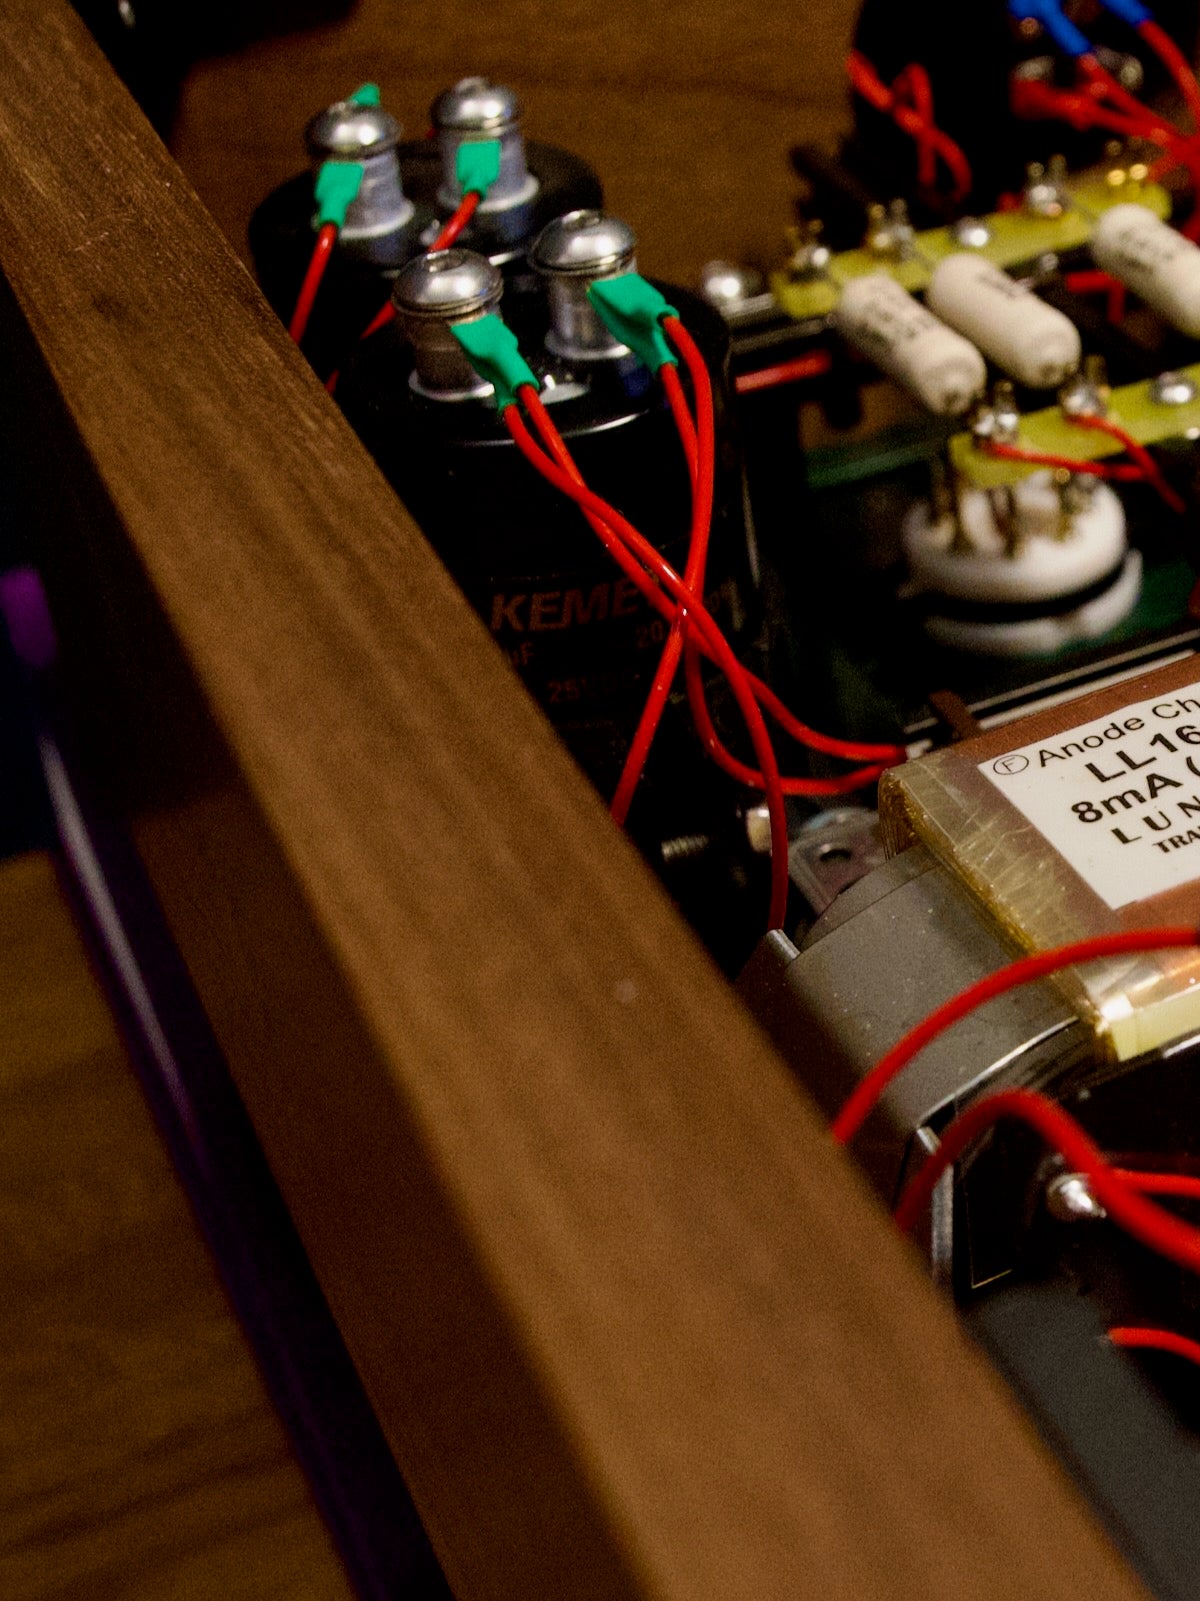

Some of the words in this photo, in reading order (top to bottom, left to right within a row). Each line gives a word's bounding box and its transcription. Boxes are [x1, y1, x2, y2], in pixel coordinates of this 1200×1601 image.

[490, 577, 641, 633] KEME
[1039, 717, 1145, 768] Anode
[1072, 772, 1182, 824] 8mA
